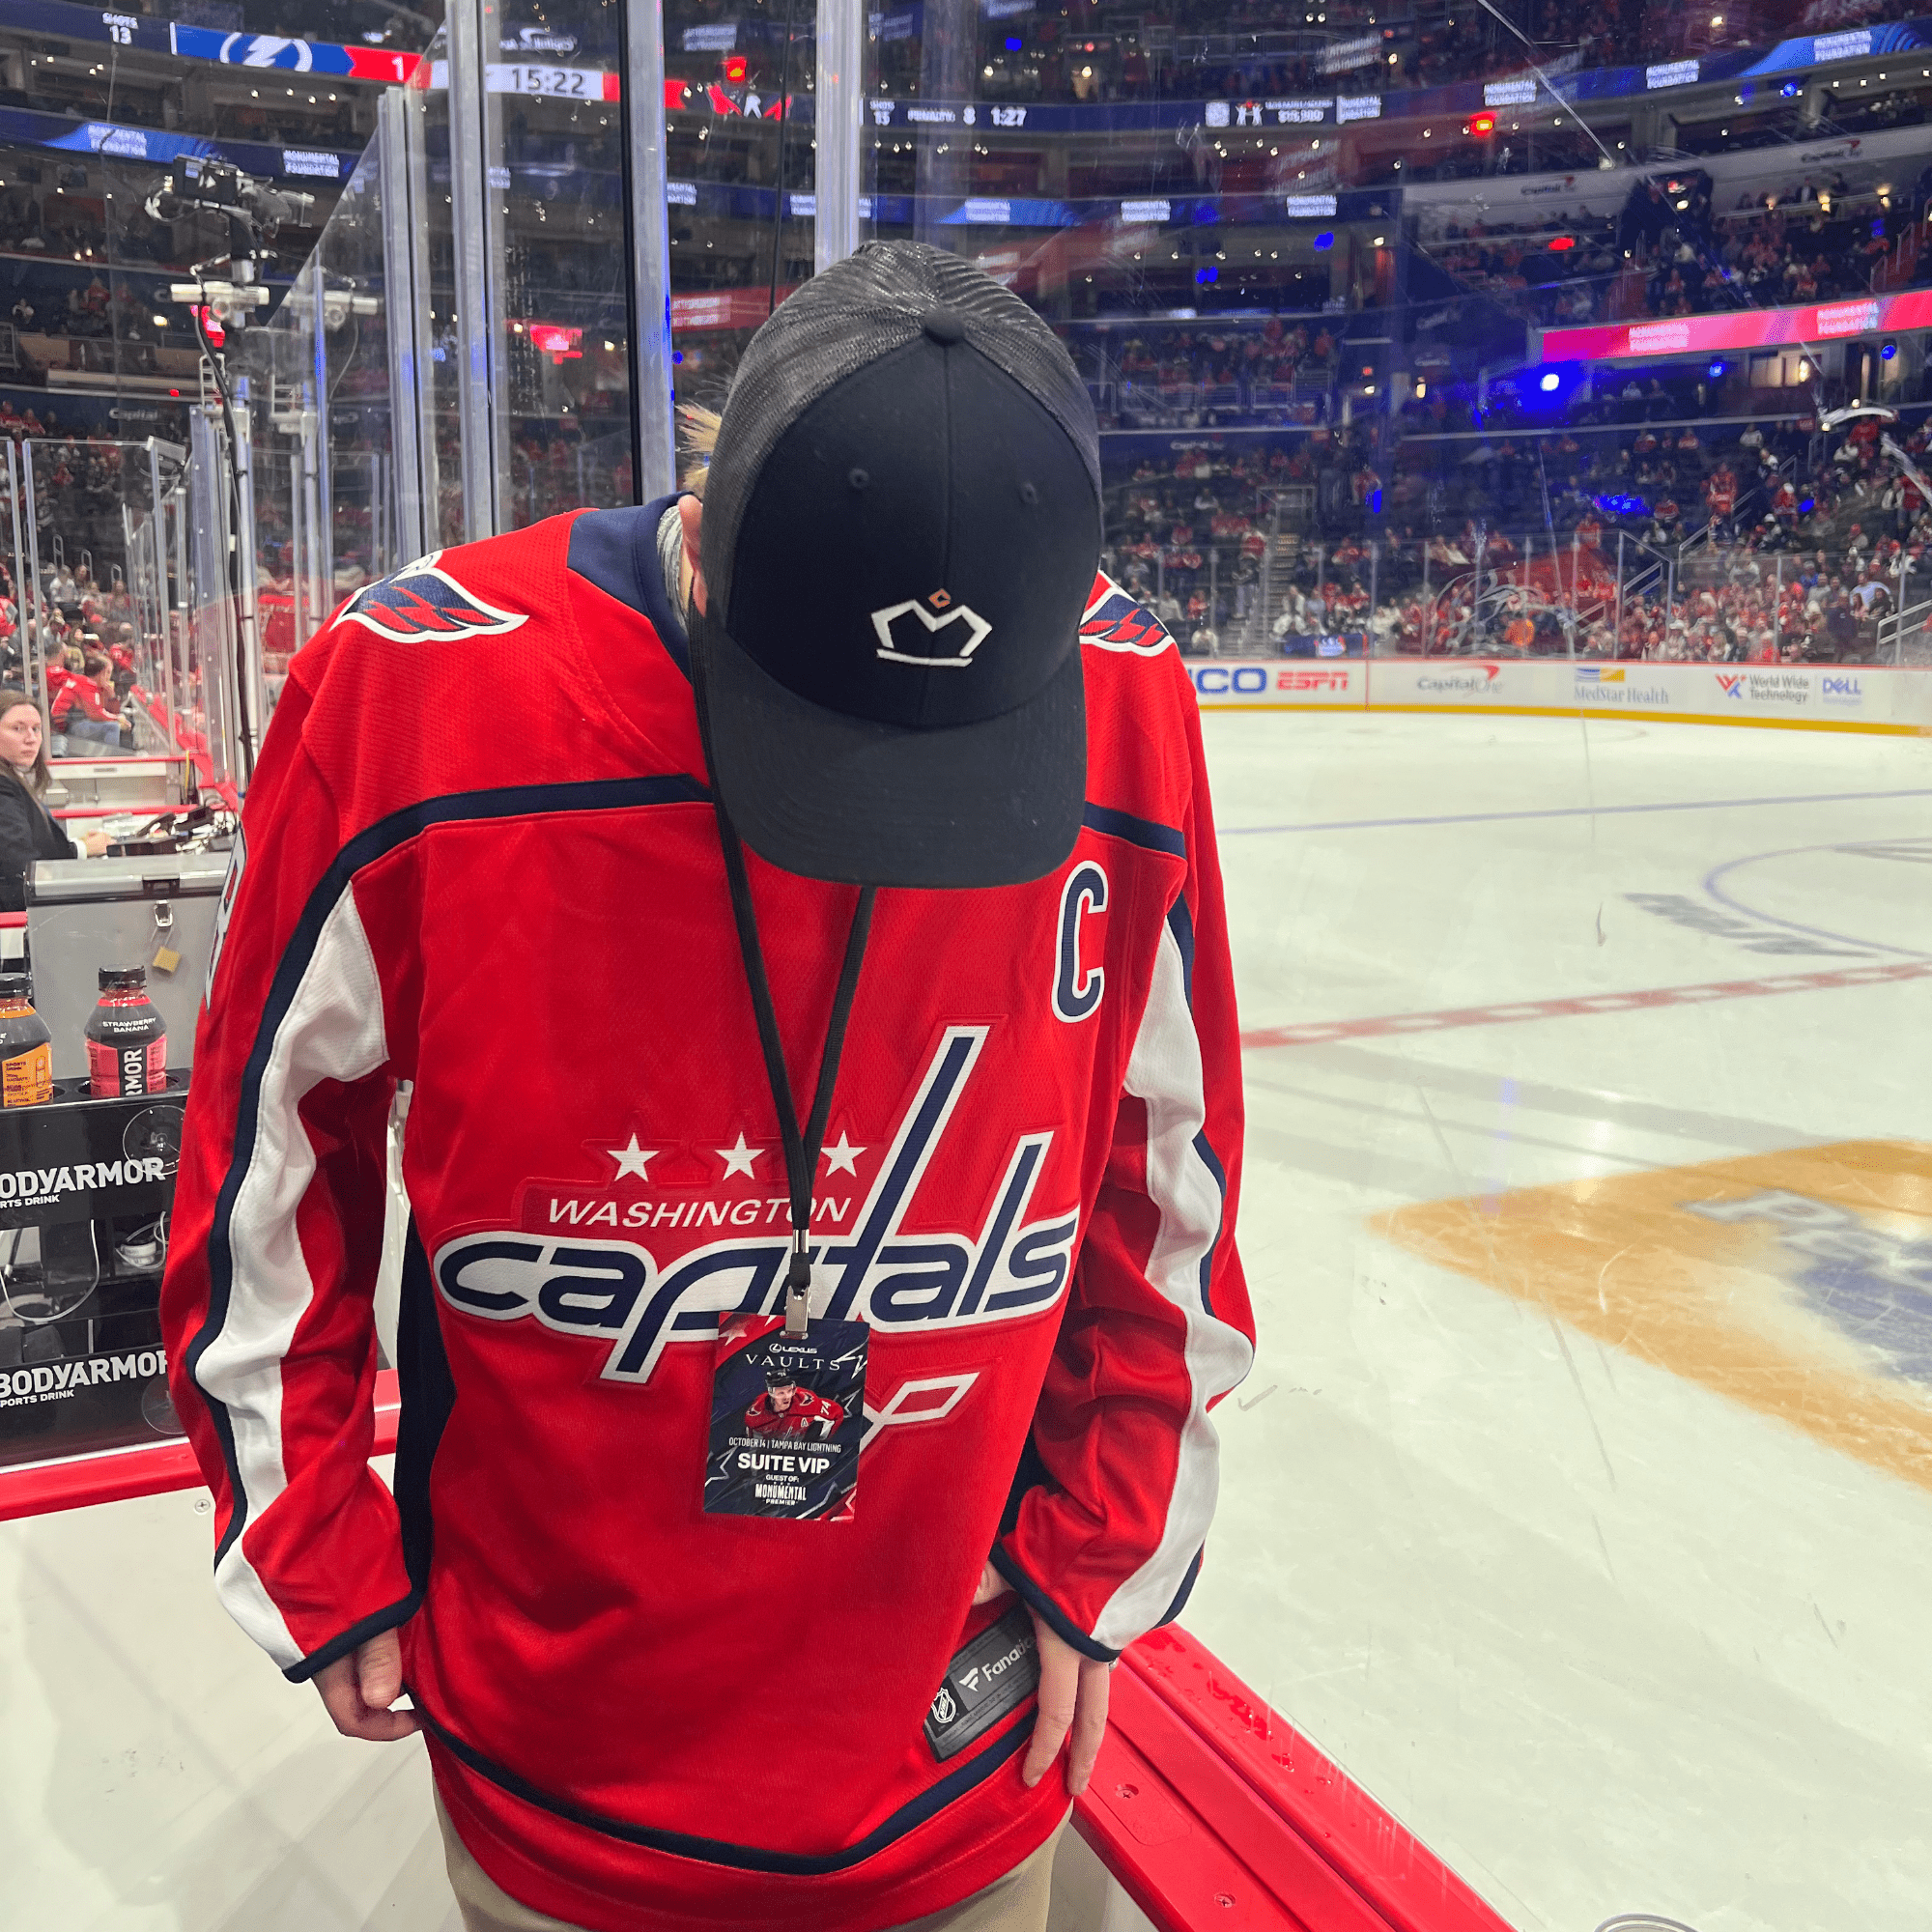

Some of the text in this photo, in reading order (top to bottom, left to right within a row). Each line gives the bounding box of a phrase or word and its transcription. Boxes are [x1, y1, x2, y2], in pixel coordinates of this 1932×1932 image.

[110, 25, 132, 44] 13
[392, 56, 405, 81] 1
[511, 68, 584, 95] 15:22
[991, 105, 1027, 127] 1:27
[1276, 670, 1349, 691] ESPN
[1749, 674, 1810, 689] World Wide
[1575, 685, 1669, 704] MedStar Health
[1750, 688, 1808, 705] Technology
[1051, 860, 1109, 1023] C
[102, 1017, 156, 1028] STRAWBERRY
[113, 1025, 150, 1034] BANANA
[25, 1194, 60, 1207] DRINK
[782, 1346, 818, 1354] LEXUS
[746, 1353, 840, 1371] VAULTS
[40, 1389, 74, 1402] DRINK
[728, 1436, 841, 1453] OCTOBER 14 TAMPA BAY LIGHTNING
[737, 1452, 831, 1474] SUITE VIP
[765, 1474, 787, 1483] GUEST
[755, 1483, 807, 1501] MONUMENTAL
